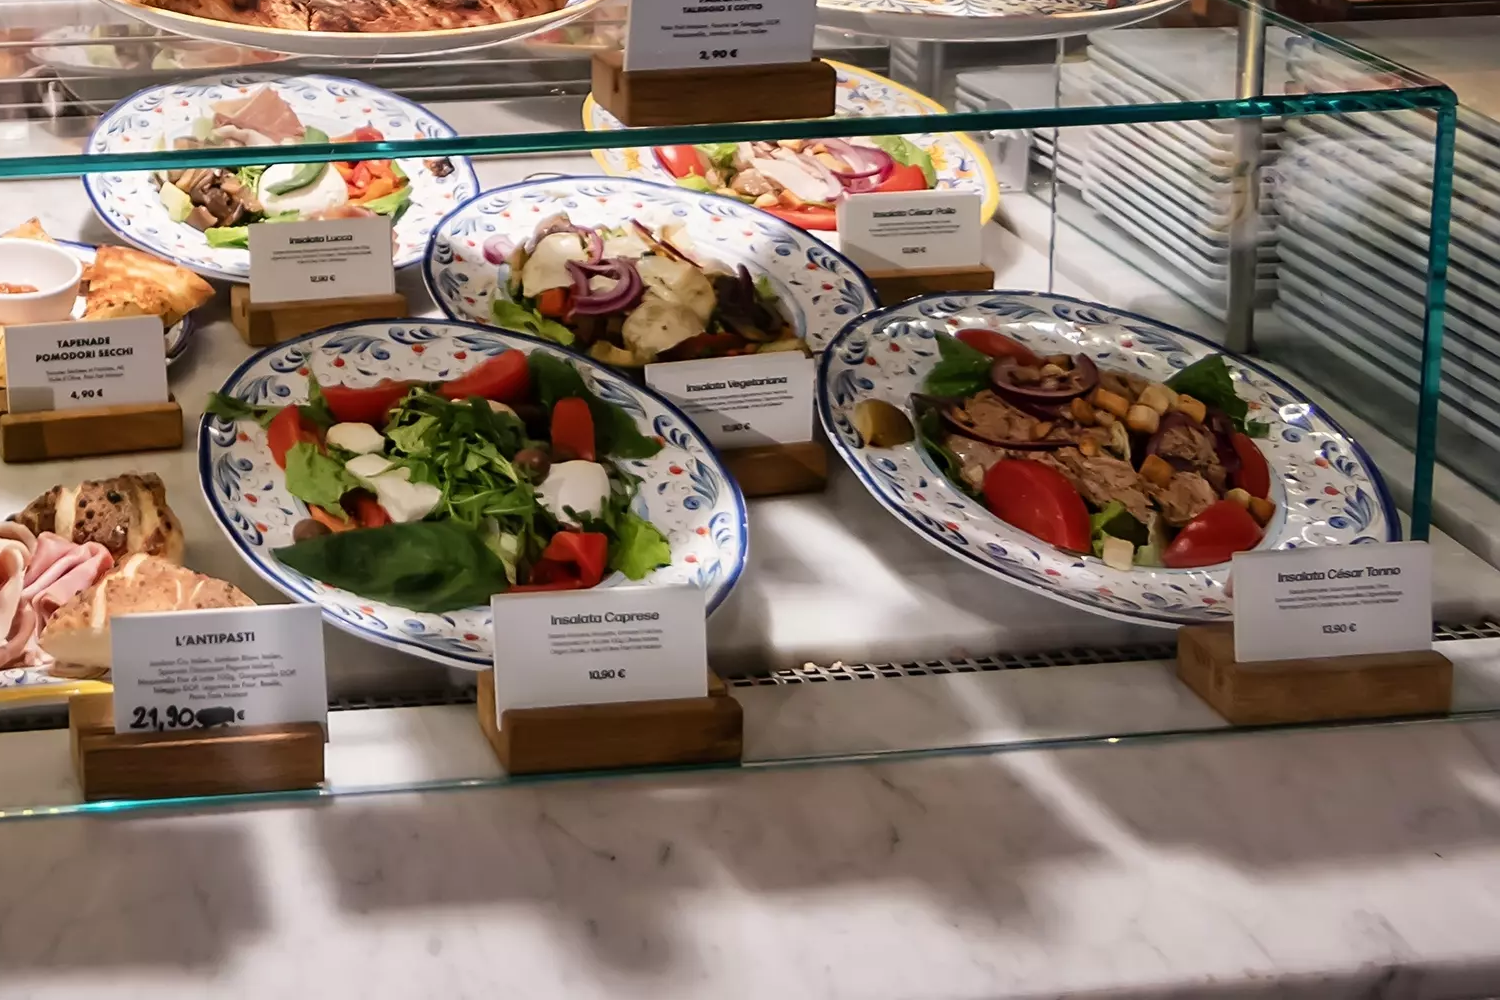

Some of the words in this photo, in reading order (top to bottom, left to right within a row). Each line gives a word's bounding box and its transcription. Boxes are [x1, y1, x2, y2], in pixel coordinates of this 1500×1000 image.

[57, 337, 110, 348] TAPENADE
[35, 350, 95, 362] POMODORI
[99, 347, 134, 357] SECCHI
[1278, 571, 1325, 583] Insalata
[1328, 568, 1364, 580] César
[1366, 566, 1401, 577] Tonno
[551, 614, 602, 626] Insalata
[604, 611, 660, 625] Caprese
[176, 632, 255, 647] L'ANTIPASTI
